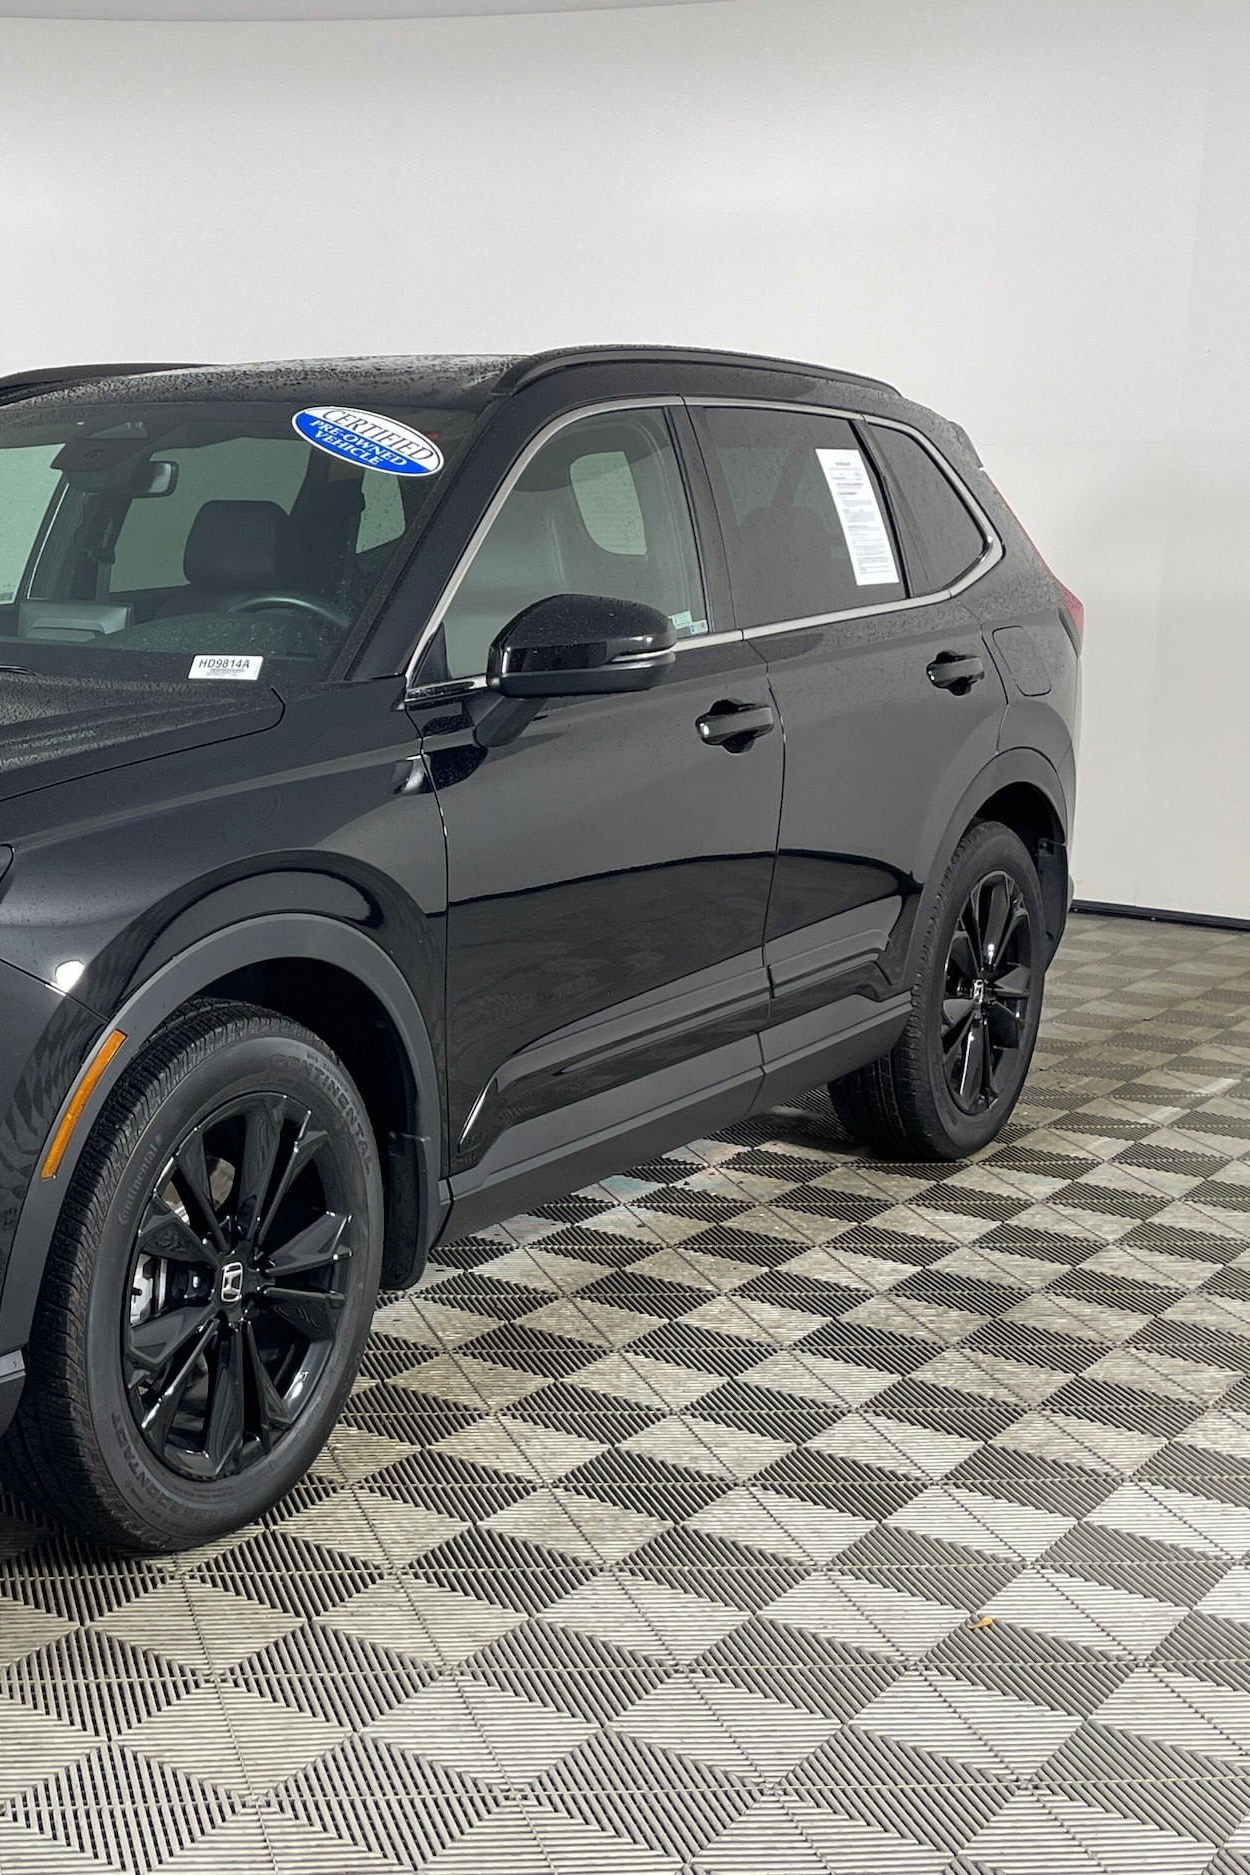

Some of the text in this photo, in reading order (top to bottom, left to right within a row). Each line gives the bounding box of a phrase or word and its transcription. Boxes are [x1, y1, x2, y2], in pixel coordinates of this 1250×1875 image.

[310, 420, 408, 466] PRE-OWNED
[315, 430, 384, 465] VEHICLE
[322, 410, 434, 461] CERTIFIED
[198, 658, 250, 669] HD9814A
